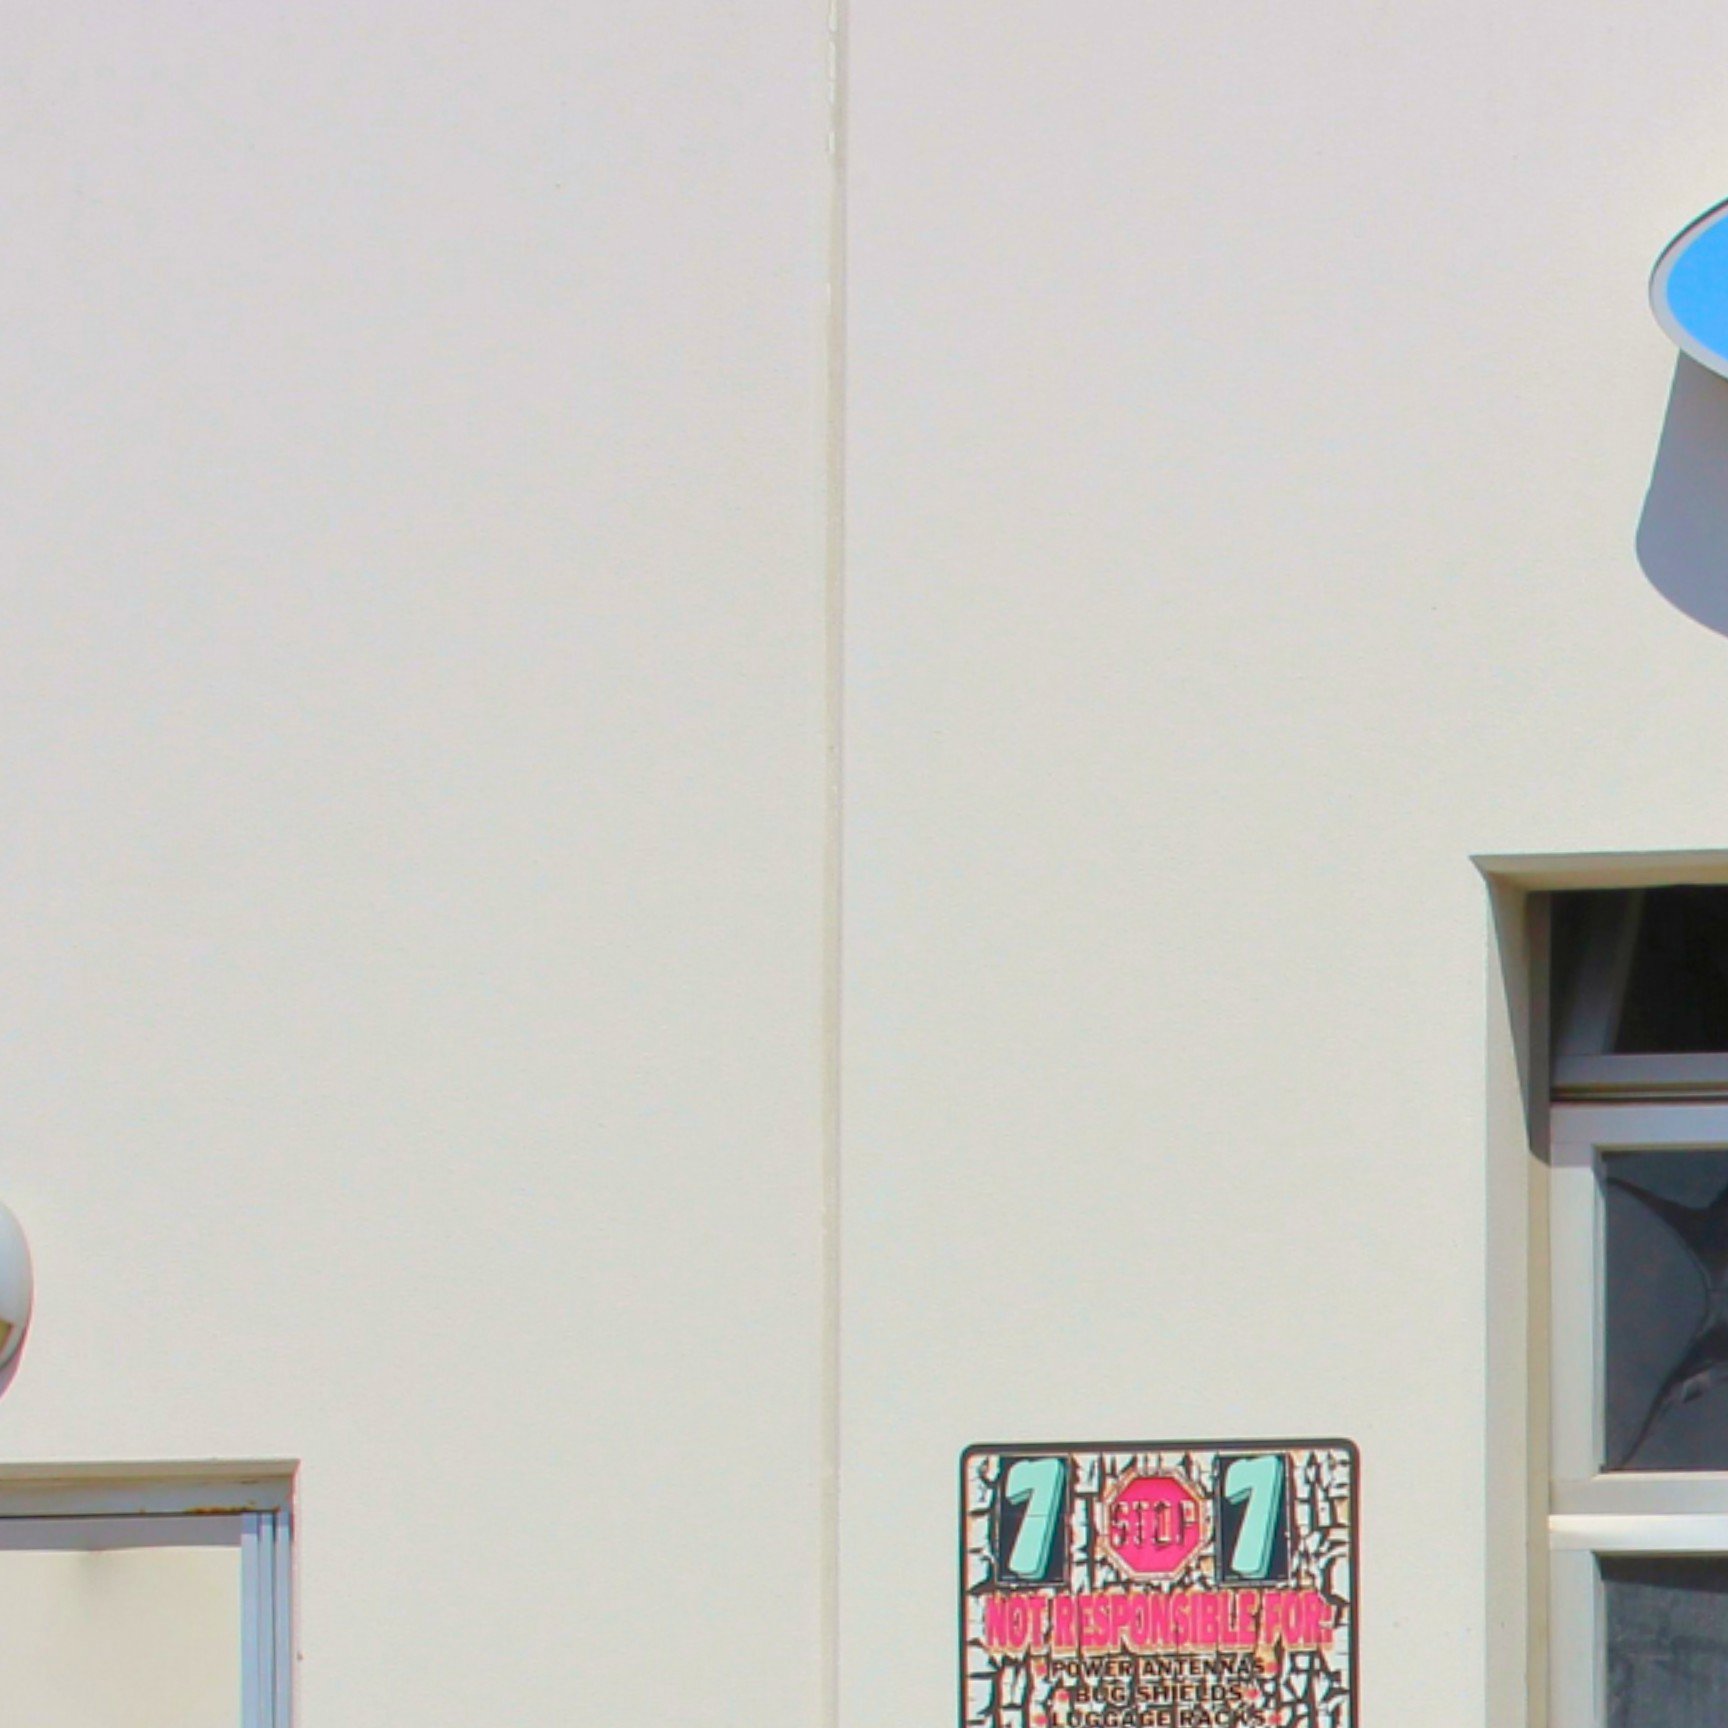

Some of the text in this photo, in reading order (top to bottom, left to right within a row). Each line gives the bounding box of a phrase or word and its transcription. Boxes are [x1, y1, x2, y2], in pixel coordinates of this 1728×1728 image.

[1110, 1498, 1198, 1548] STOP
[985, 1590, 1048, 1647] NOT
[1054, 1590, 1255, 1647] RESPONSIBLE
[1052, 1657, 1265, 1677] POWER ANTENNAS
[1076, 1684, 1243, 1703] BUG SHIELDS
[1051, 1709, 1266, 1728] LUGGAGE RACKS
